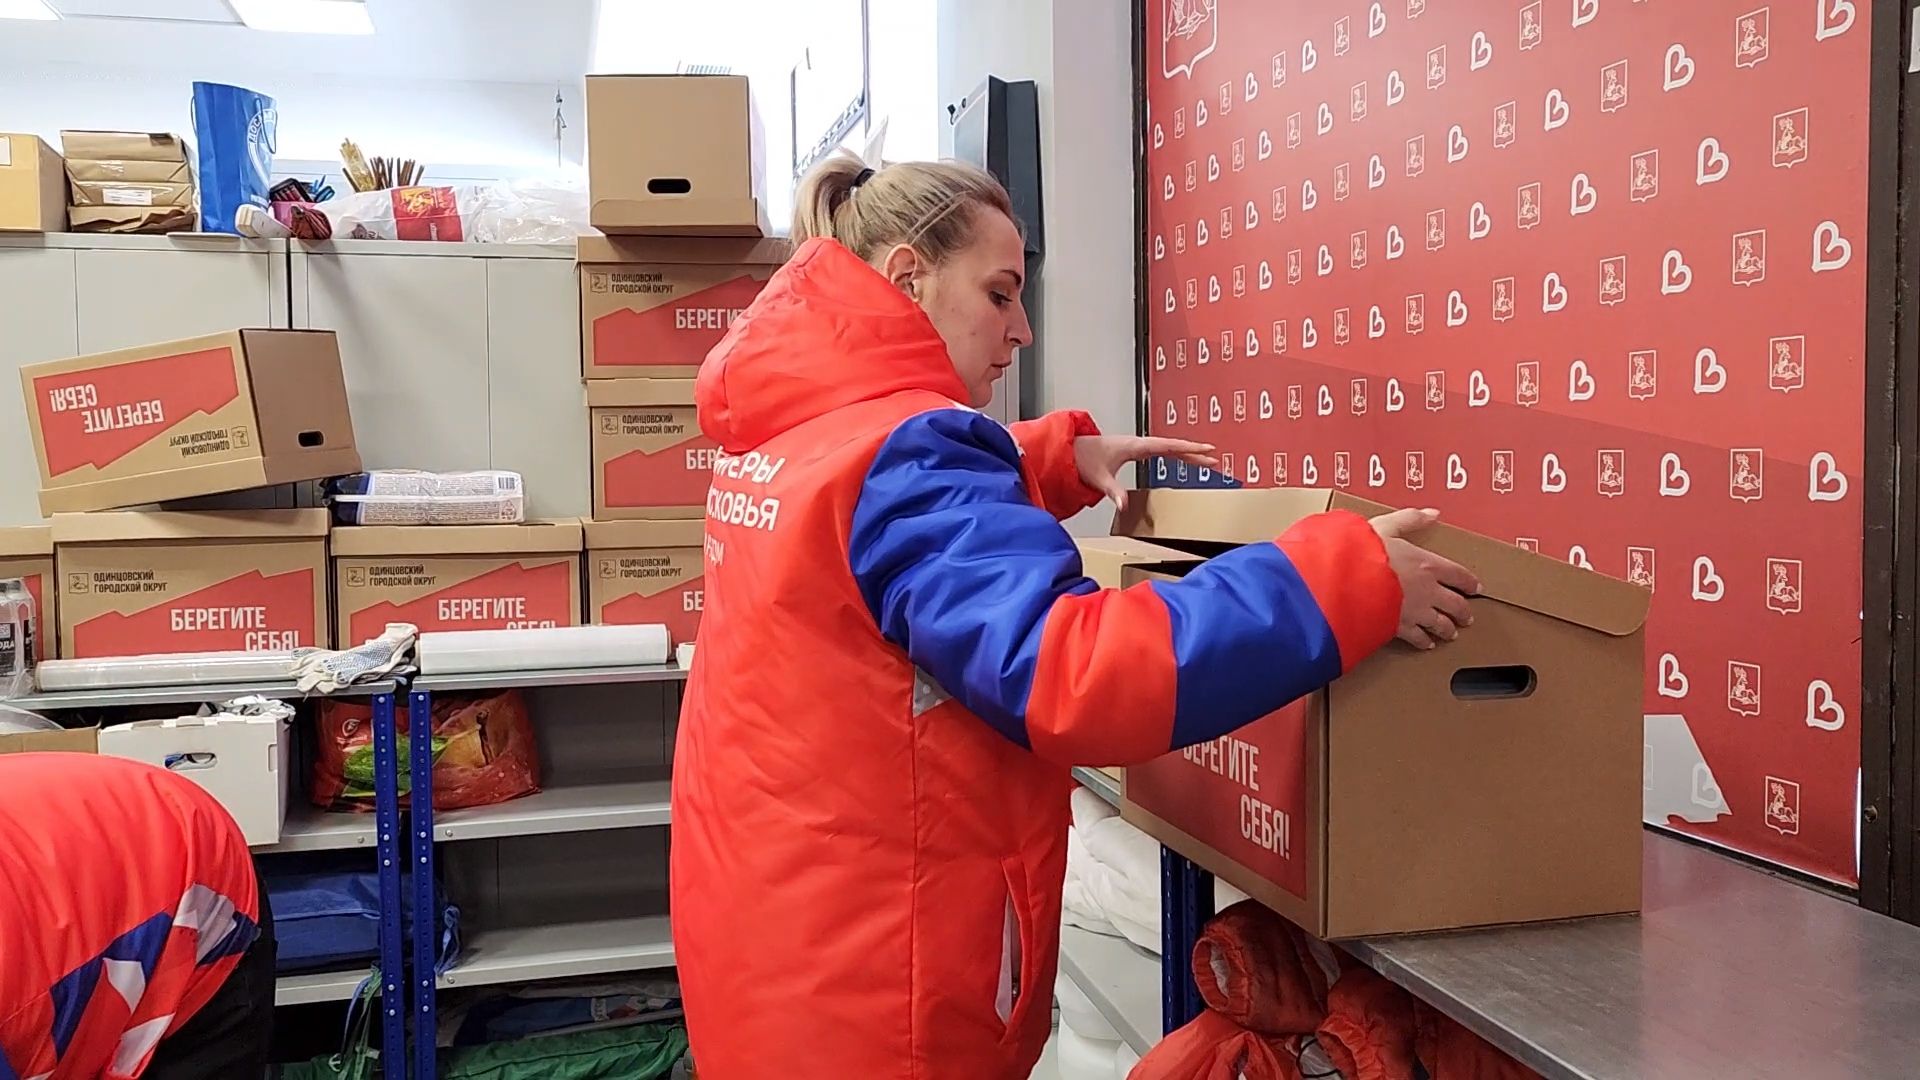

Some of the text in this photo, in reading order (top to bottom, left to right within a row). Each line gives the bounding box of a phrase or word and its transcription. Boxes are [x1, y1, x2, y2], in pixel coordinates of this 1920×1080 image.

[611, 272, 663, 283] ОДИНЦОВСКИЙ
[611, 283, 674, 294] ГОРОДСКОЙ ОКРУГ
[675, 308, 747, 329] БЕРЕГИ
[49, 383, 98, 412] СЕБЯ!
[81, 399, 165, 434] БЕРЕГИТЕ
[622, 414, 674, 425] ОДИНЦОВСКИЙ
[622, 424, 684, 435] ГОРОДСКОЙ ОКРУГ
[707, 485, 780, 531] СКОВЬЯ
[619, 556, 671, 568] ОДИНЦОВСКИЙ
[93, 569, 154, 582] ОДИНЦОВСКИЙ
[369, 565, 424, 577] ОДИНЦОВСКИЙ
[620, 568, 682, 578] ГОРОДСКОЙ ОКРУГ
[94, 581, 168, 593] ГОРОДСКОЙ ОКРУГ
[369, 575, 437, 587] ГОРОДСКОЙ ОКРУГ
[438, 597, 526, 621] БЕРЕГИТЕ
[170, 606, 267, 632] БЕРЕГИТЕ
[245, 630, 299, 652] СЕБЯ!
[1240, 793, 1290, 861] СЕБЯ!
